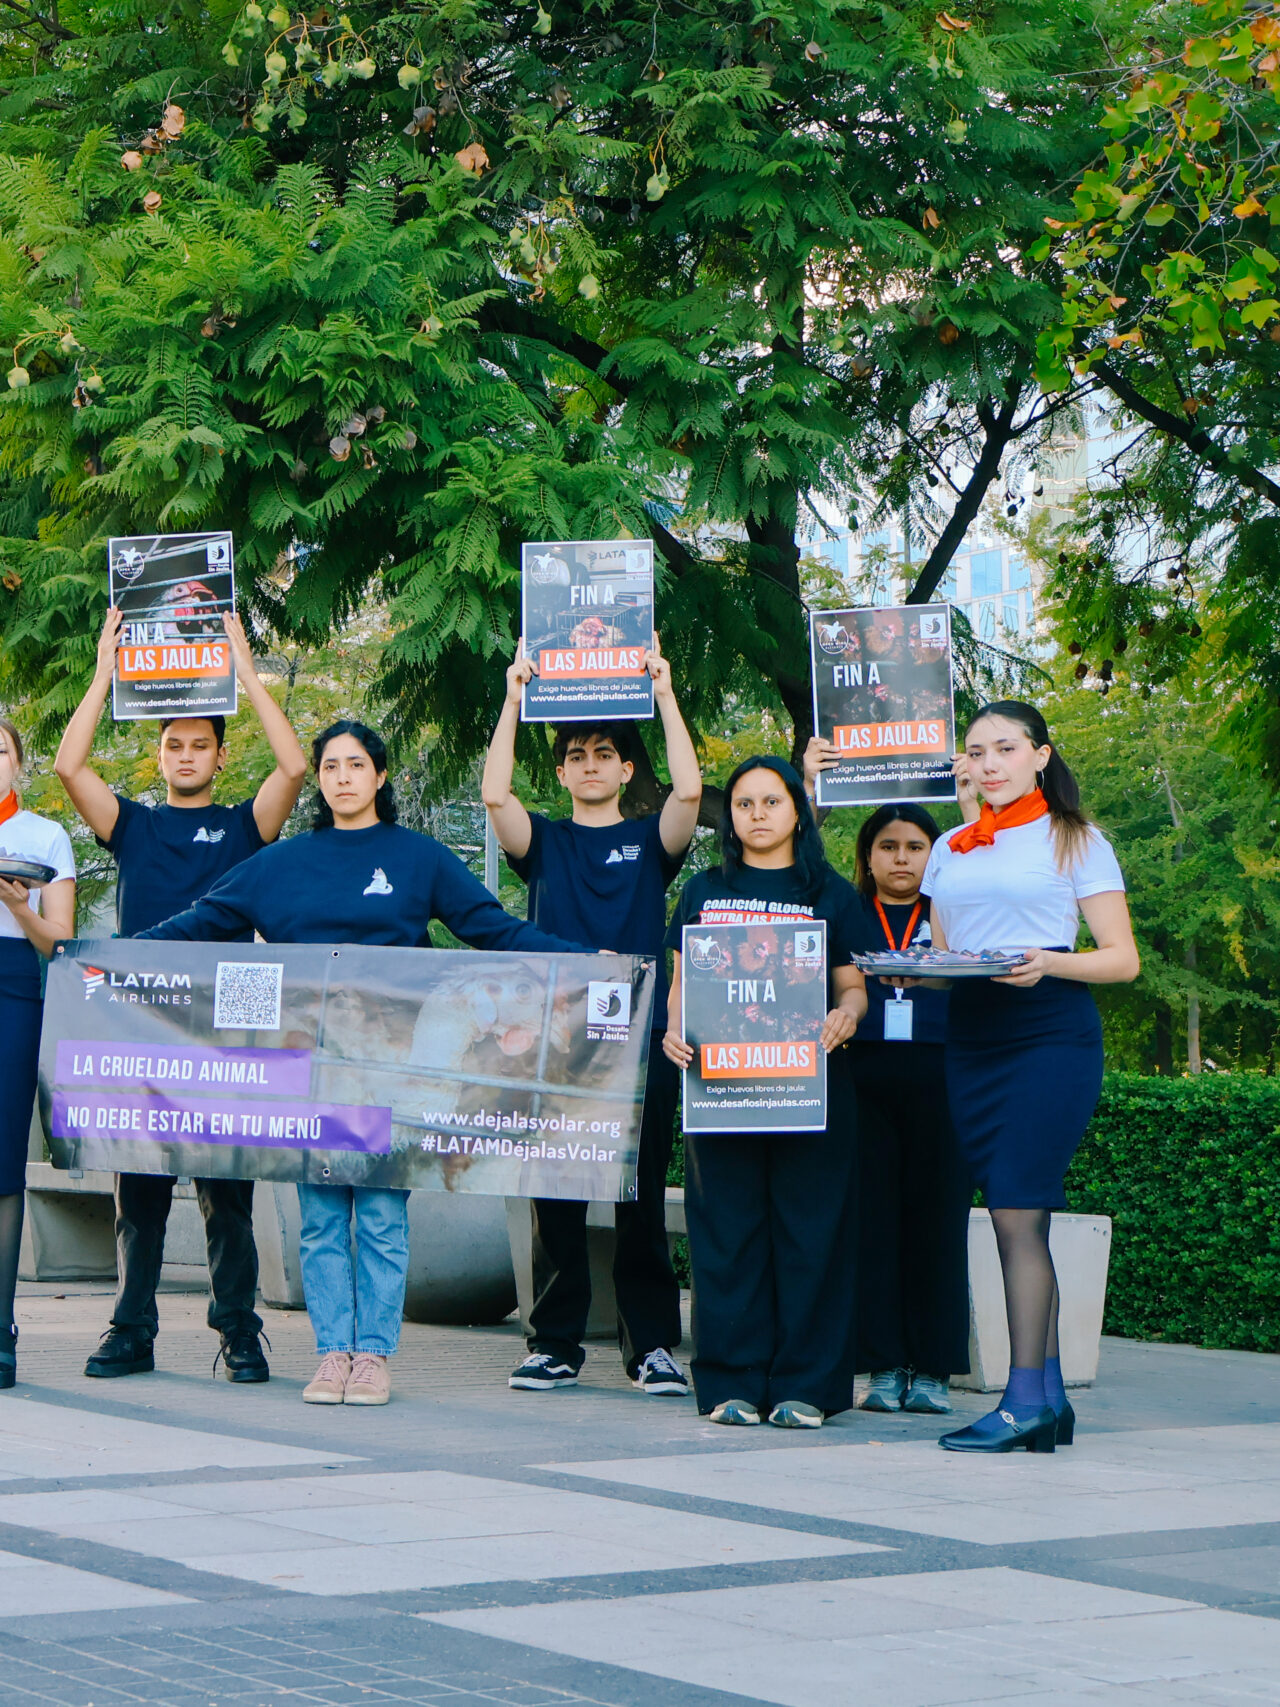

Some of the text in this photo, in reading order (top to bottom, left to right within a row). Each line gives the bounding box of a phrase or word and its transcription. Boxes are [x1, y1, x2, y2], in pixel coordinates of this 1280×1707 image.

[571, 585, 614, 605] FIN A
[121, 623, 165, 645] FIN A
[124, 647, 223, 671] LAS JAULAS
[545, 651, 639, 671] LAS JAULAS
[834, 663, 880, 687] FIN A
[530, 692, 648, 702] www.desafiosinjaulas.com
[539, 685, 559, 693] Exige
[560, 684, 587, 692] huevos
[125, 697, 227, 708] www.desafiosinjaulas.com
[839, 724, 939, 749] LAS JAULAS
[856, 763, 885, 772] huevos
[826, 771, 951, 784] www.desafiosinjaulas.com
[703, 898, 814, 916] COALICIÓN GLOBAL
[701, 912, 744, 924] CONTRA
[746, 914, 767, 925] LAS
[110, 972, 191, 989] LATAM
[109, 993, 192, 1005] AIRLINES
[728, 980, 776, 1003] FIN A
[587, 1031, 629, 1040] Sin Jaulas
[707, 1045, 810, 1069] LAS JAULAS
[73, 1055, 269, 1085] LA CRUELDAD ANIMAL
[706, 1085, 726, 1094] Exige
[728, 1085, 753, 1093] huevos
[692, 1098, 820, 1109] www.desafiosinjaulas.com
[67, 1106, 321, 1140] NO DEBE ESTAR EN TU MENÚ
[423, 1109, 621, 1138] www.dejalasvolar.org
[421, 1135, 616, 1162] #LATAMDéjalasVolar
